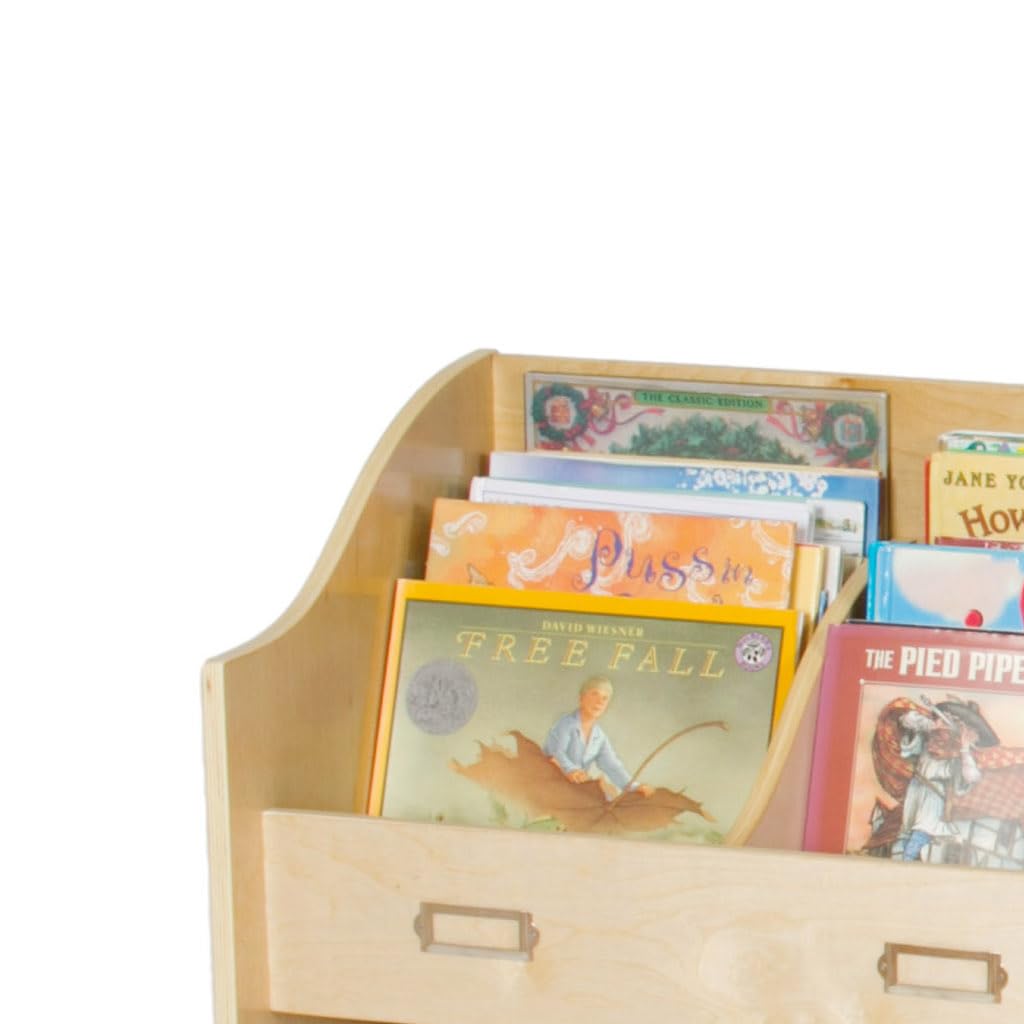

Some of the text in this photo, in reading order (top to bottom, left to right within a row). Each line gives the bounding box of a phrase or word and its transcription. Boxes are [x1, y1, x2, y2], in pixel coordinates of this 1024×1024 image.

[641, 390, 764, 408] THE CLASSIC EDITION
[943, 470, 997, 488] JANE
[571, 528, 714, 592] Puss
[543, 620, 644, 637] DAVID WIESNER
[456, 631, 588, 667] FREE
[608, 642, 725, 678] FALL
[866, 649, 894, 669] THE
[899, 646, 960, 680] PIED
